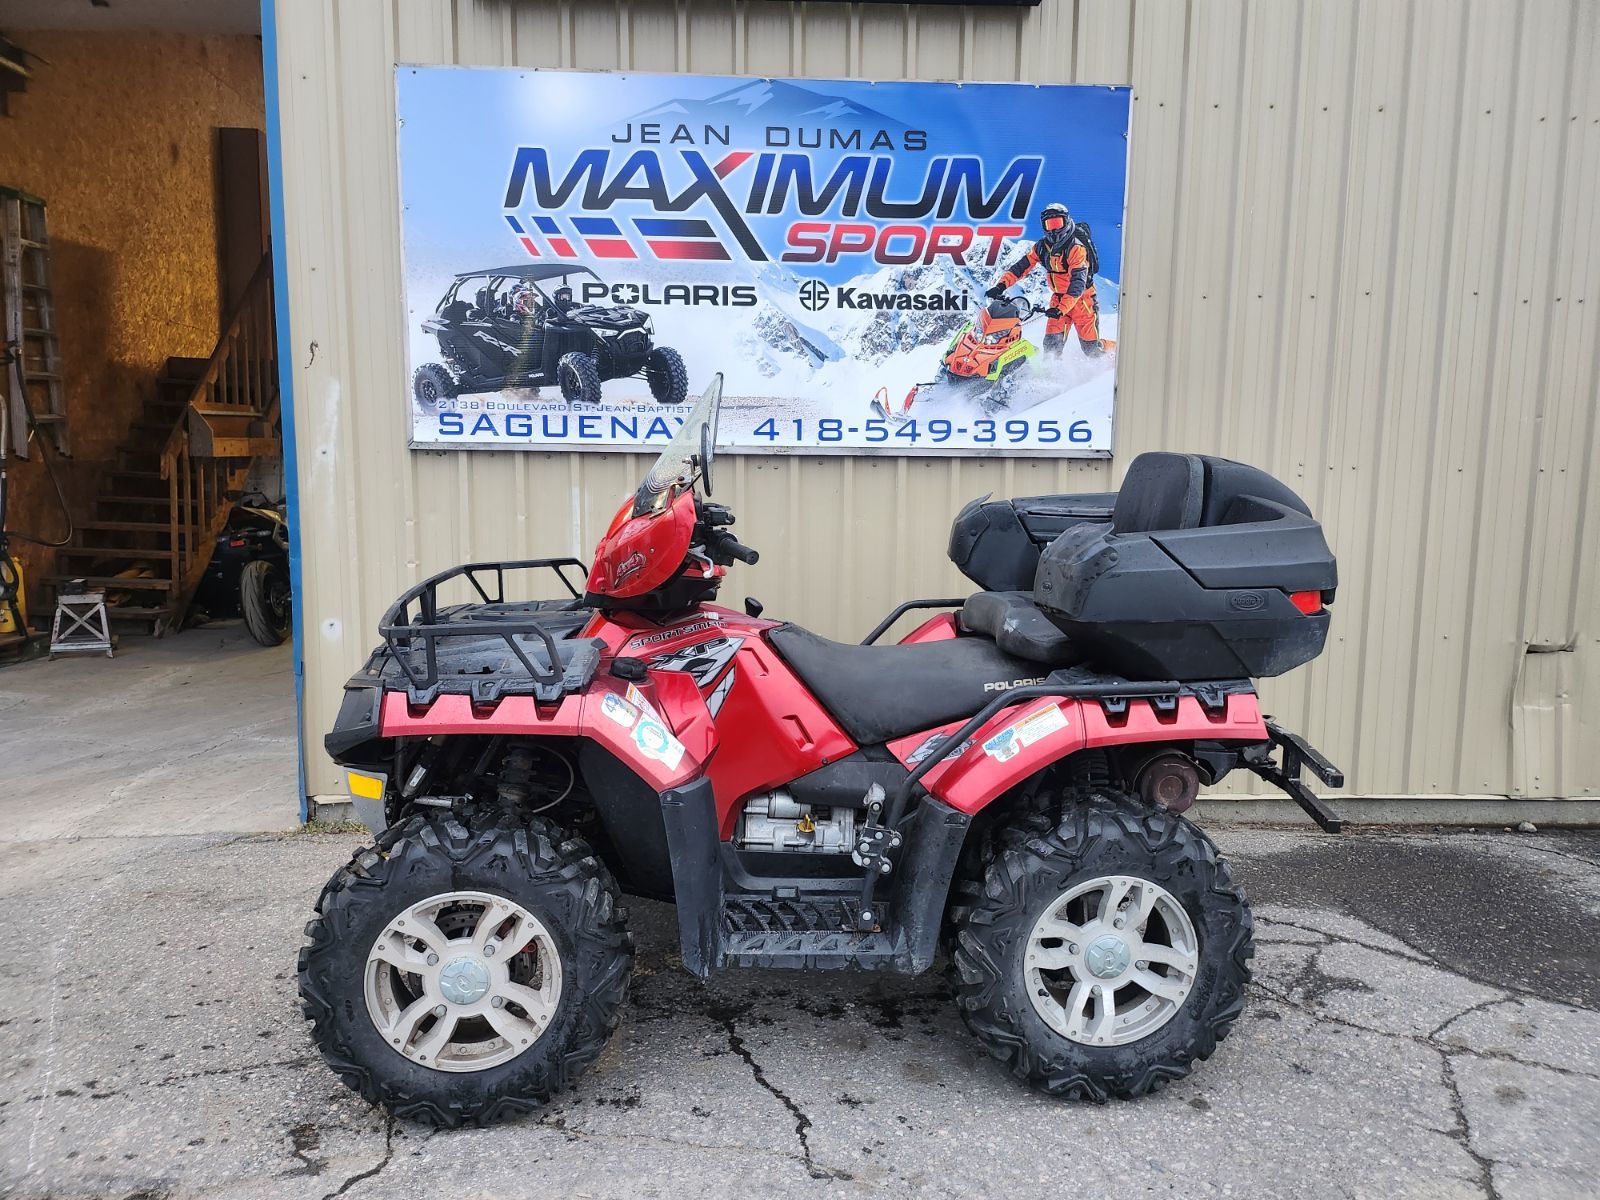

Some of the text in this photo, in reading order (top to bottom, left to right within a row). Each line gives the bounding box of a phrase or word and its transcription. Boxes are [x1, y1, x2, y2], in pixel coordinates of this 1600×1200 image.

[611, 122, 928, 151] JEAN DUMAS
[504, 147, 1045, 262] MAXIMUM
[781, 222, 1024, 266] SPORT
[582, 282, 758, 306] POLARIS
[837, 286, 968, 311] Kawasaki
[438, 400, 480, 410] 2138
[438, 413, 684, 440] SAGUENA
[753, 418, 1093, 443] 418-549-3956
[983, 676, 1046, 692] POLARIS
